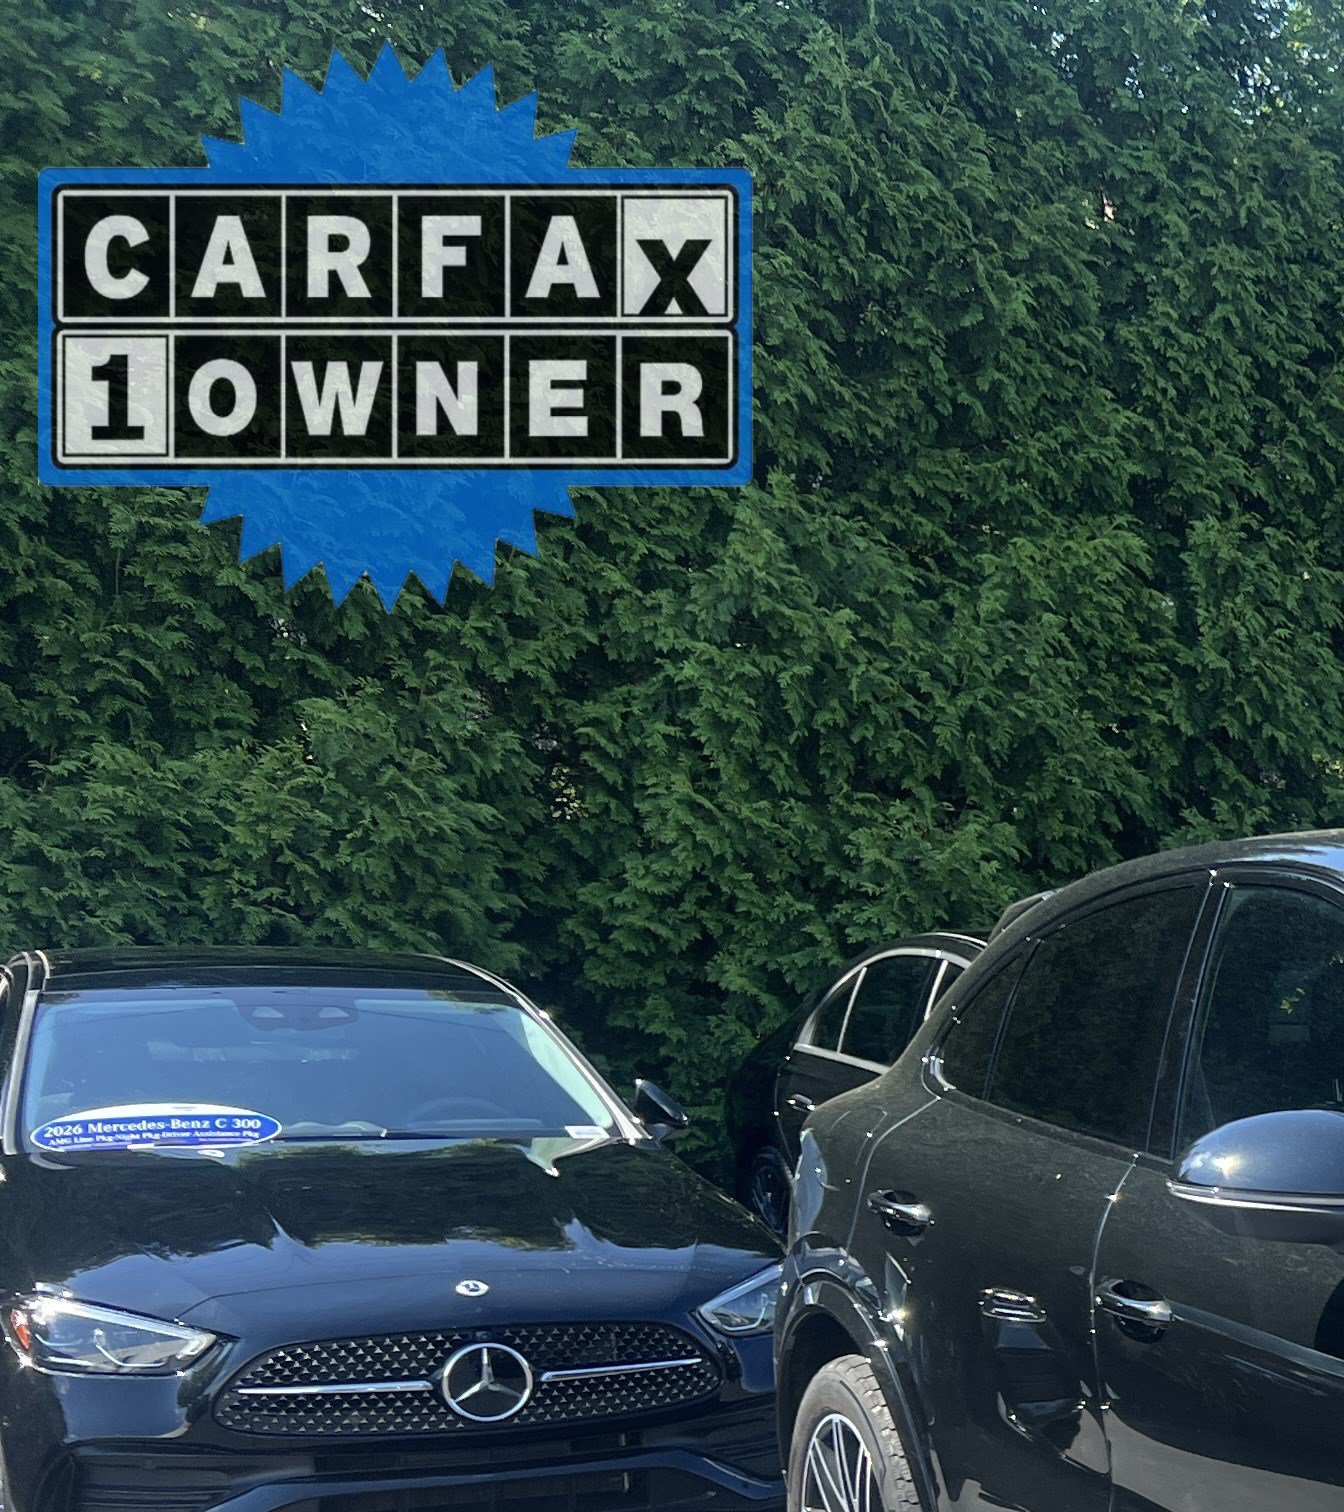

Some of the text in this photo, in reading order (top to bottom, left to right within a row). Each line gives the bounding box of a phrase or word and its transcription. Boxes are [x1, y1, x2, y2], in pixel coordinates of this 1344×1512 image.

[43, 1117, 262, 1138] 2026 Mercedes-Benz C 300
